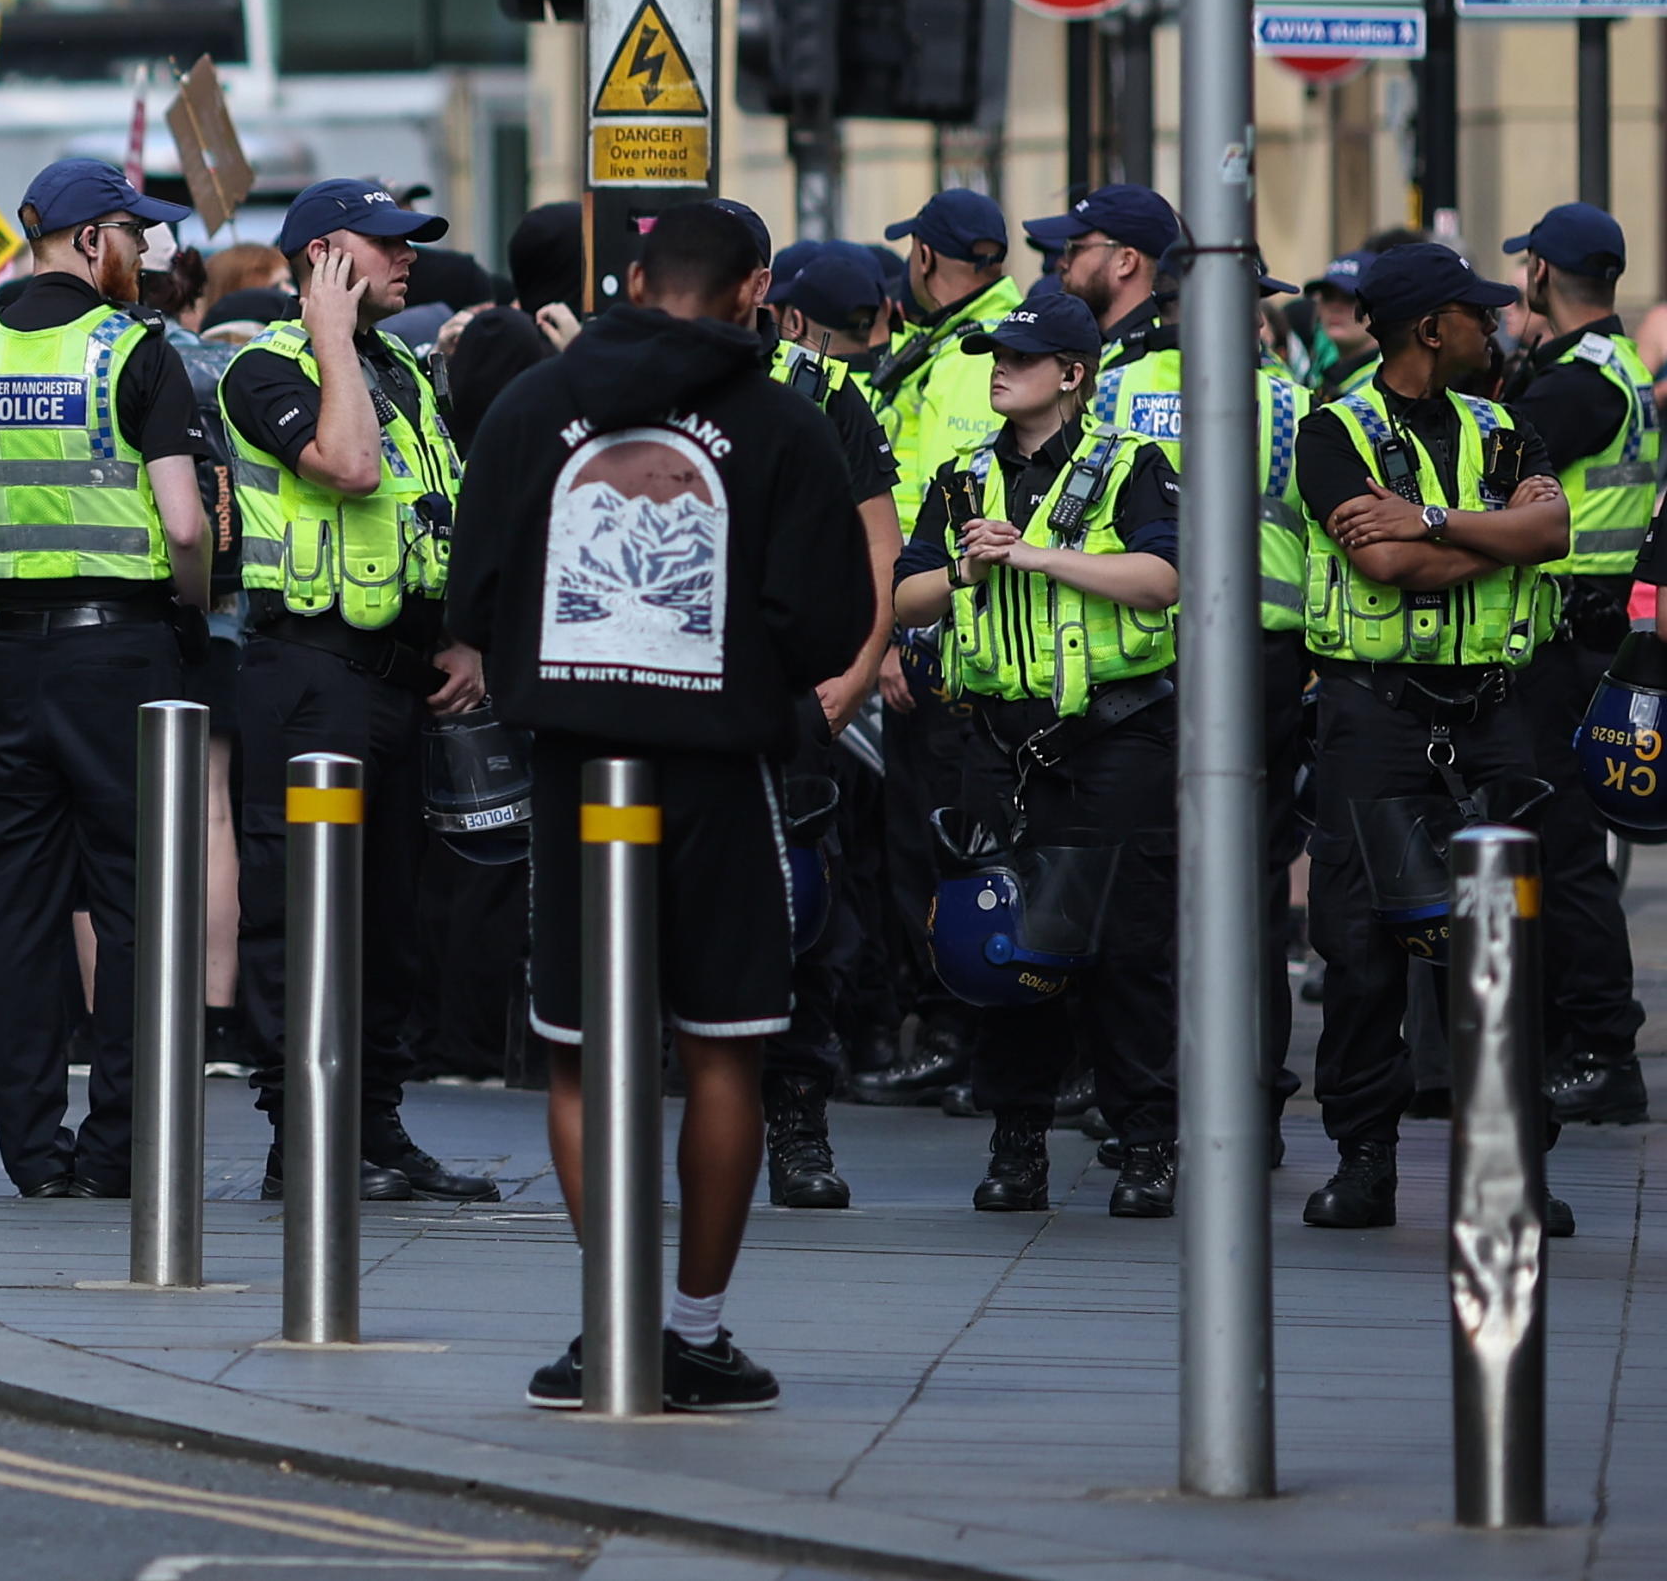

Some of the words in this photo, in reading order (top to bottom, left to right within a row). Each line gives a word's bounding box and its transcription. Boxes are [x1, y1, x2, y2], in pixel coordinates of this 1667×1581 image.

[615, 128, 683, 143] DANGER
[610, 147, 688, 161] Overhead
[610, 164, 636, 177] live
[644, 164, 688, 177] wires
[272, 339, 298, 354] 17834
[12, 382, 82, 396] MANCHESTER
[278, 407, 300, 428] 17834
[947, 415, 993, 433] POLICE
[665, 409, 732, 459] LANC
[214, 465, 233, 553] patagonia
[539, 666, 570, 682] THE
[574, 666, 629, 684] WHITE
[632, 668, 723, 692] MOUNTAIN
[1591, 725, 1633, 746] 15626
[1634, 728, 1662, 761] G
[1602, 757, 1657, 797] CK
[467, 805, 513, 828] POLICE
